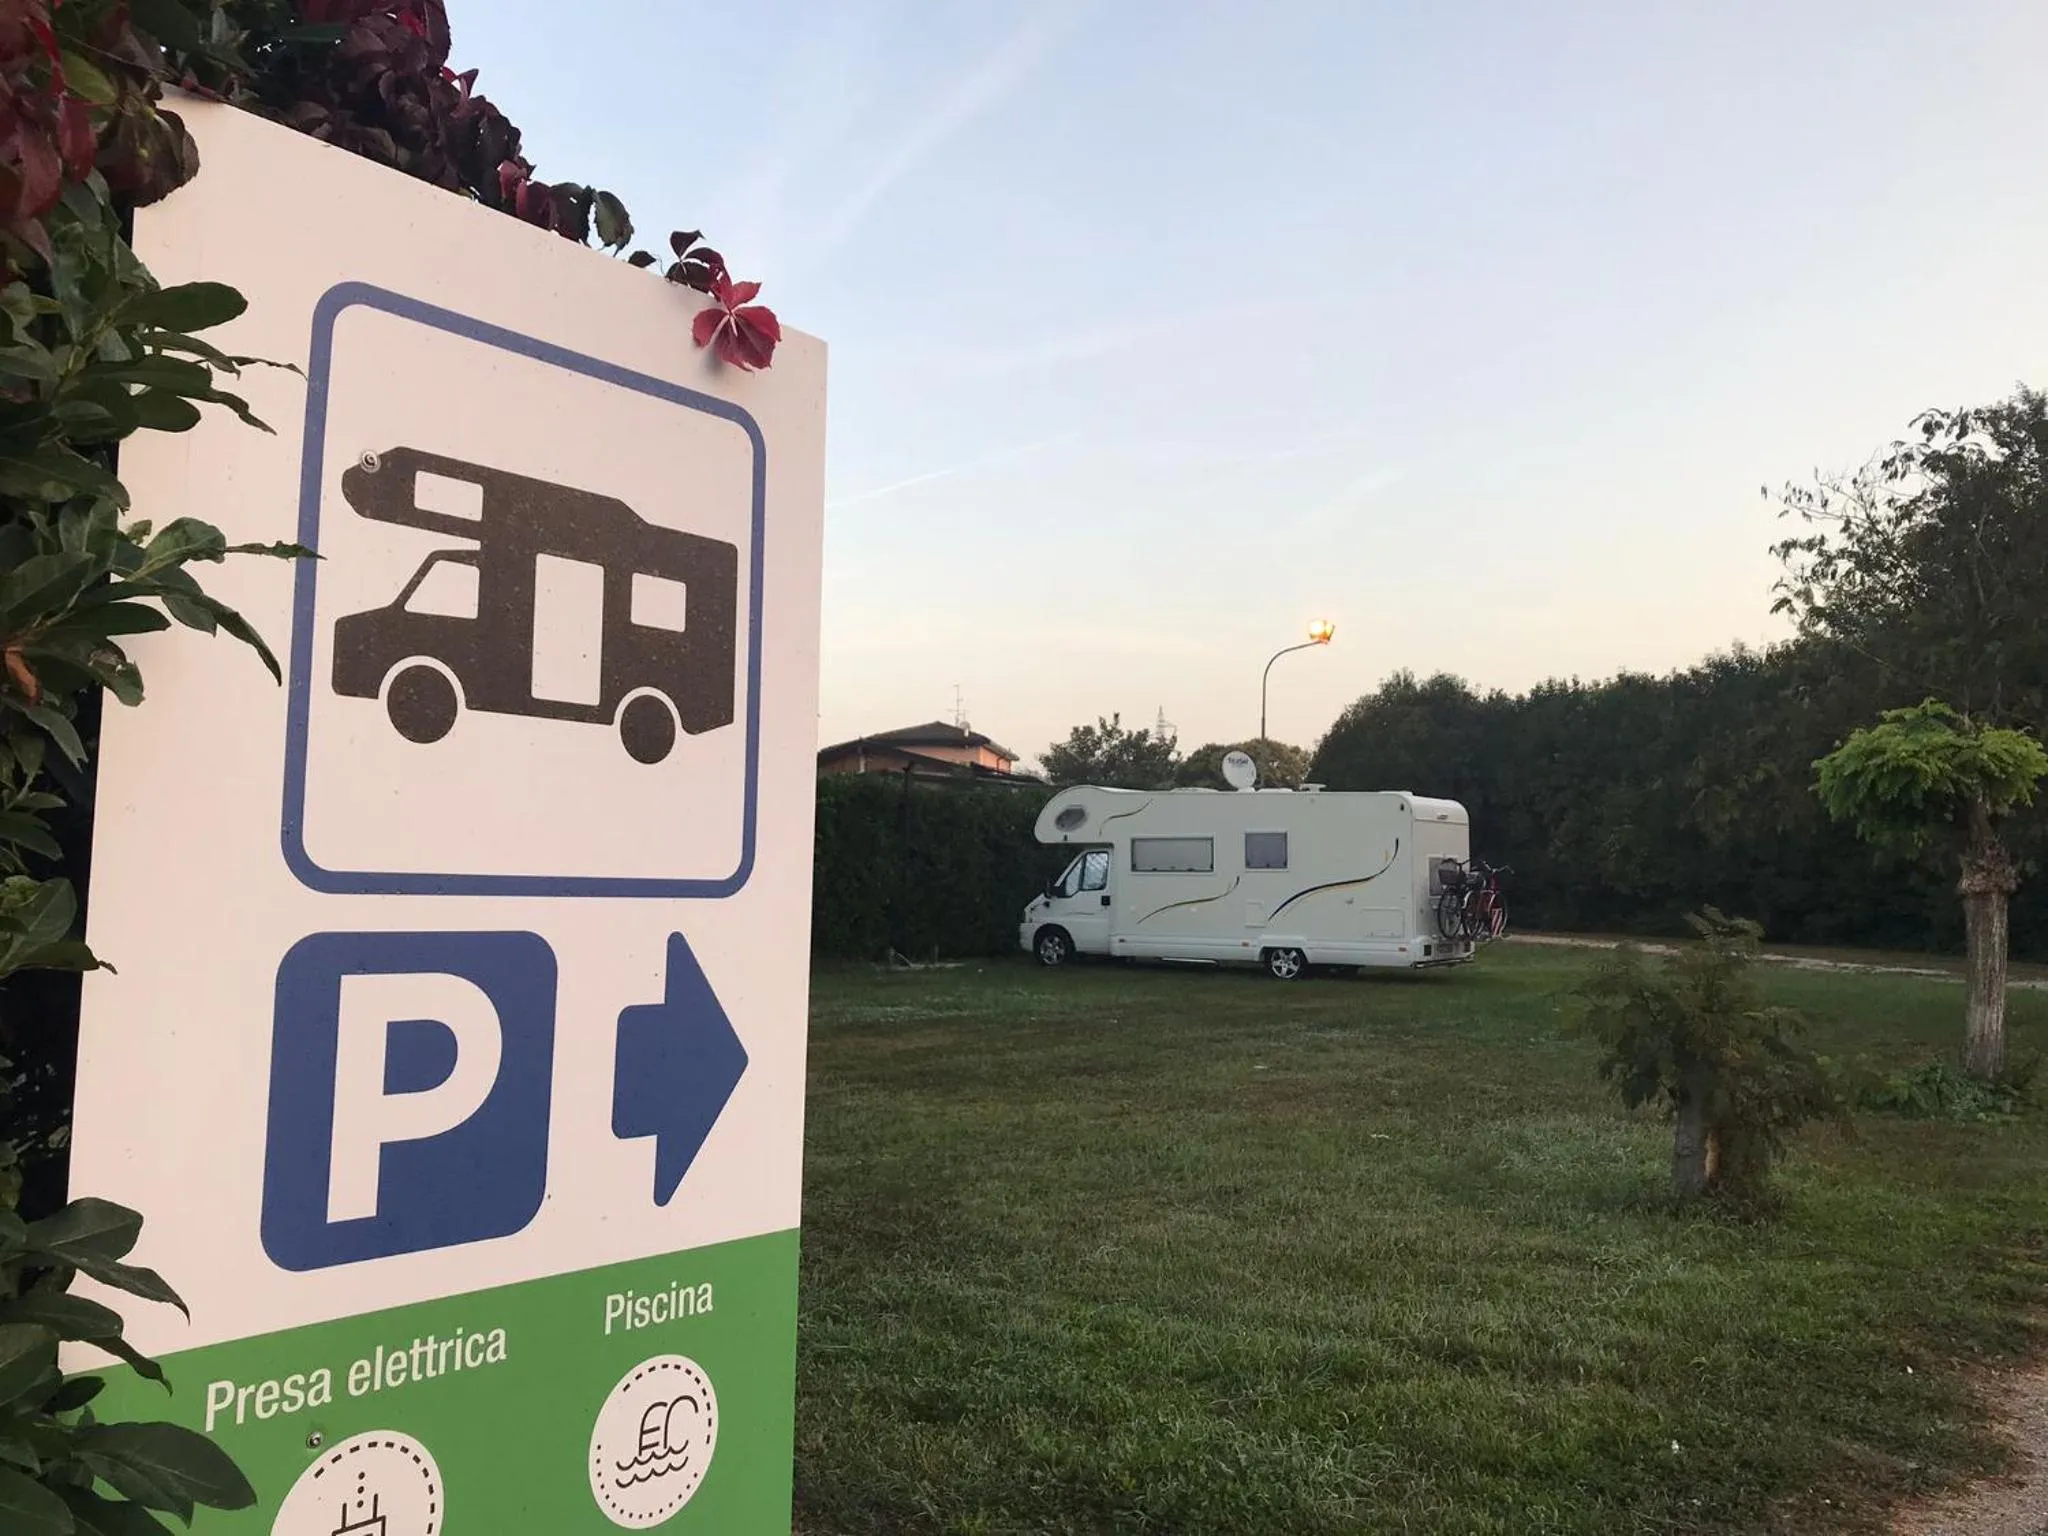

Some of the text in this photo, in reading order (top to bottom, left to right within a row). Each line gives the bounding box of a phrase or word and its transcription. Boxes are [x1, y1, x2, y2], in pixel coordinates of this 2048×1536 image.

[326, 972, 503, 1224] P
[604, 1281, 715, 1335] Piscina
[205, 1327, 507, 1433] Presa elettrica
